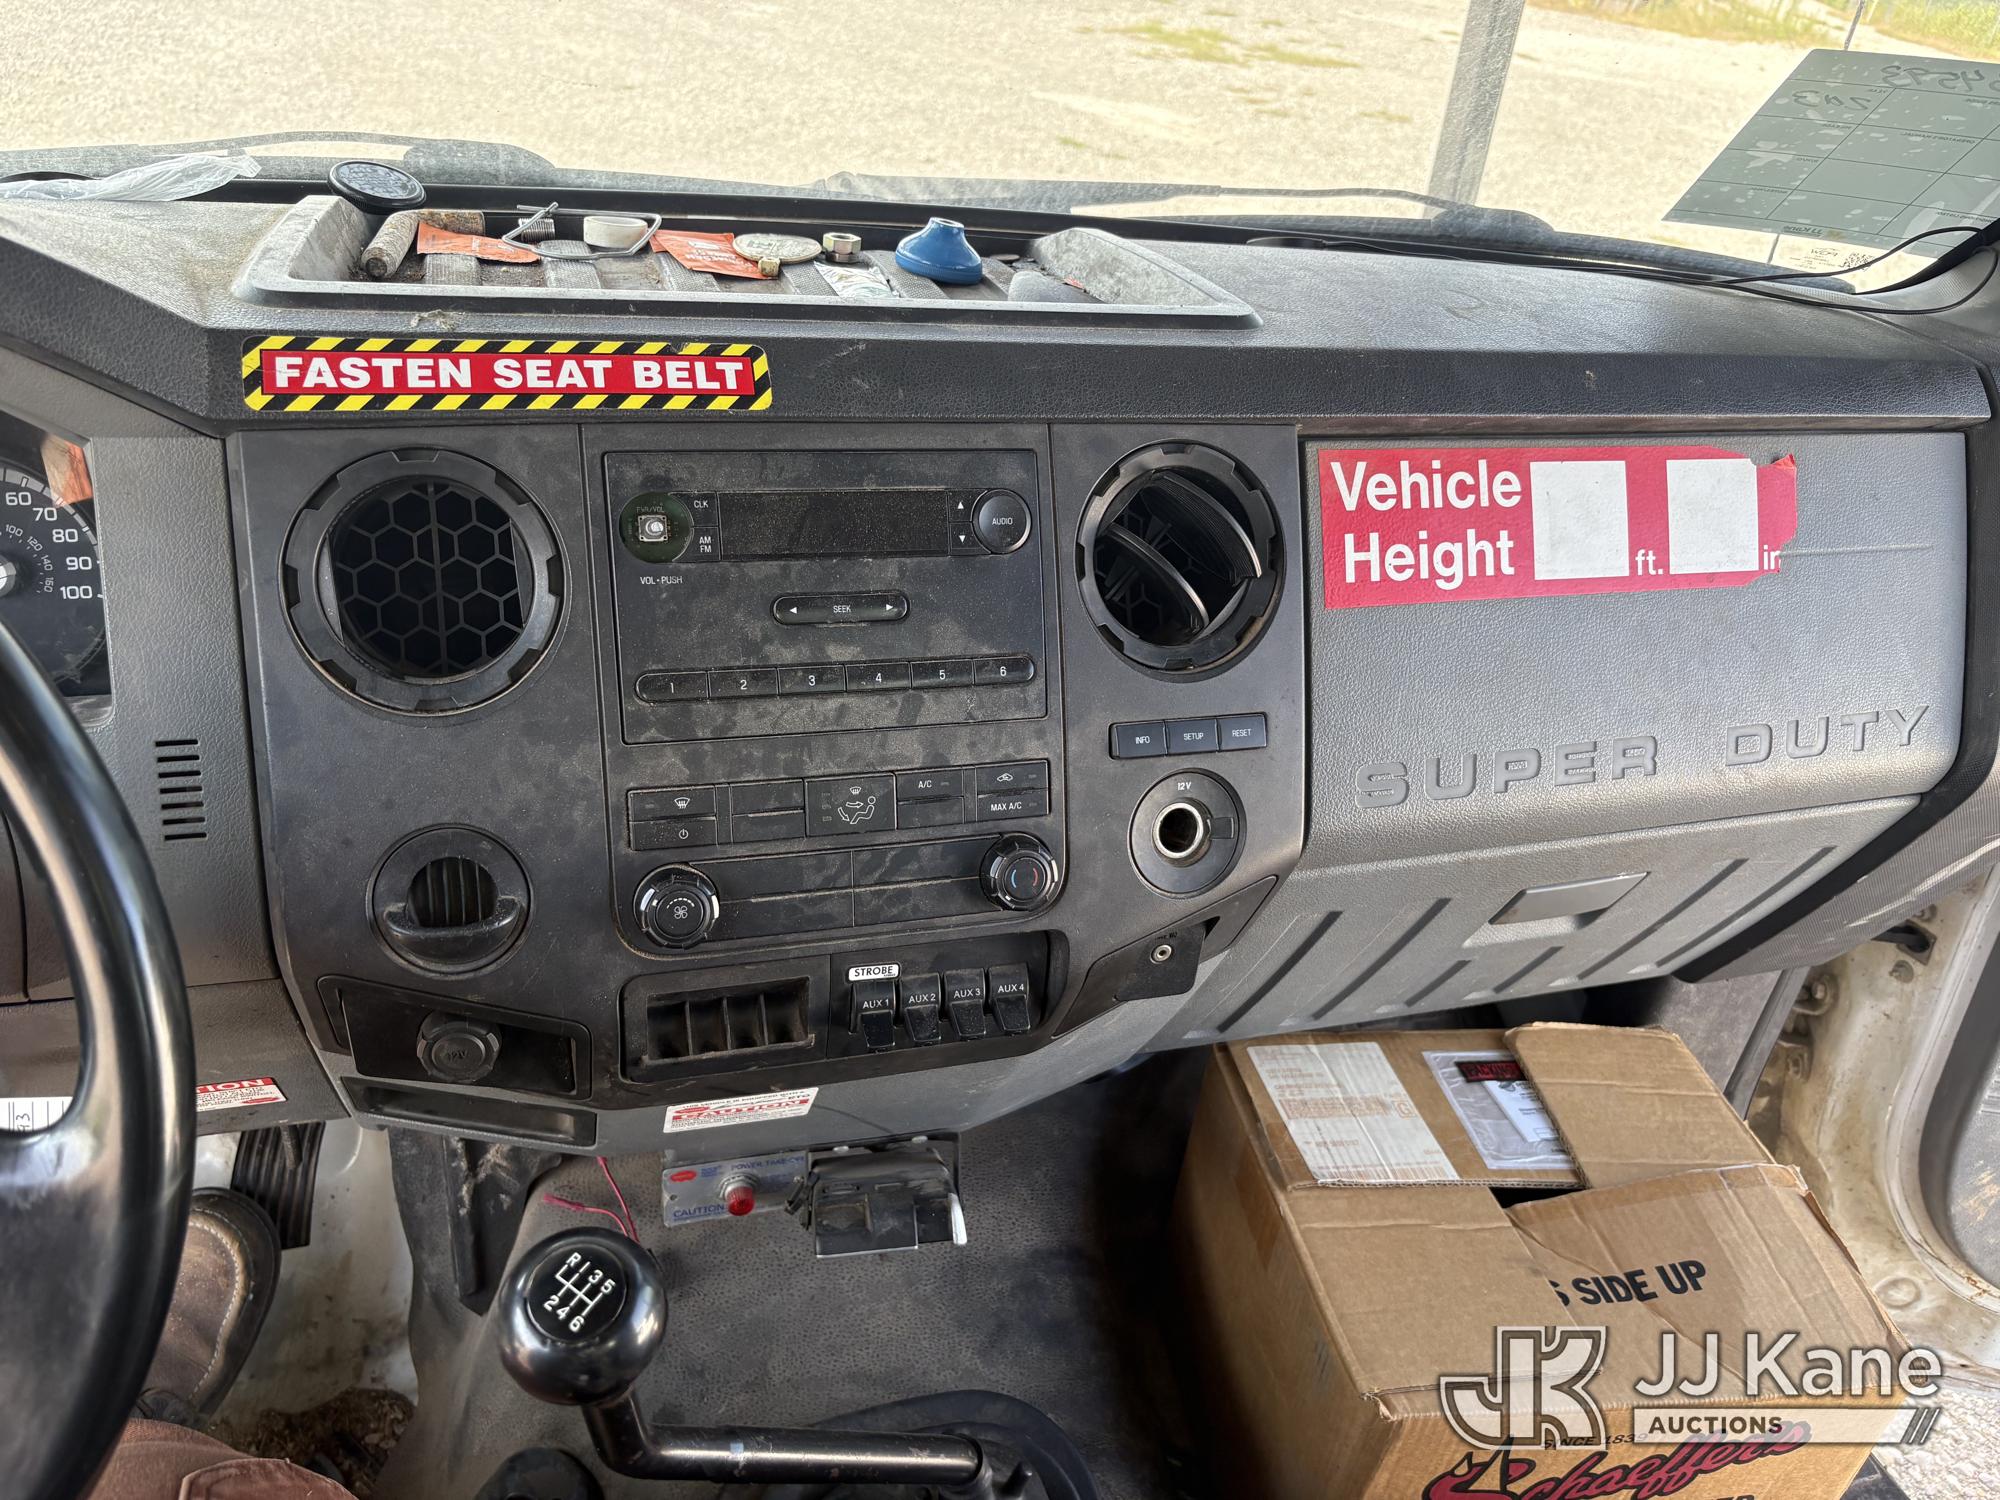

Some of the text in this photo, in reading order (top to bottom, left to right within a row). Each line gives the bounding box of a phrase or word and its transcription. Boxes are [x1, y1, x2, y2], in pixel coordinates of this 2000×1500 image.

[275, 356, 744, 390] FASTEN SEAT BELT
[1331, 459, 1522, 511] Vehicle
[5, 492, 32, 506] 60
[693, 500, 709, 509] CLK
[32, 507, 58, 521] 70
[992, 517, 1013, 526] AUDIO
[5, 524, 24, 537] 100
[52, 529, 79, 543] 80
[26, 536, 43, 552] 120
[699, 536, 712, 545] AM
[699, 545, 712, 553] FM
[41, 554, 53, 571] 140
[66, 556, 92, 571] 90
[1344, 528, 1514, 590] Height
[1635, 549, 1663, 576] ft.
[661, 575, 683, 584] PUSH
[60, 585, 93, 599] 100
[832, 604, 852, 613] SEEK
[875, 672, 883, 684] 4
[938, 669, 946, 681] 5
[999, 665, 1007, 678] 6
[739, 679, 748, 691] 2
[808, 674, 816, 687] 3
[669, 681, 676, 694] 1
[1183, 732, 1204, 741] SETUP
[1232, 728, 1252, 737] RESET
[1135, 736, 1151, 745] INFO
[1356, 704, 1929, 808] SUPER DUTY
[918, 779, 932, 789] A/C
[990, 802, 1022, 812] MAX A/C
[854, 965, 893, 977] STROBE
[954, 987, 981, 998] AUX 3
[997, 983, 1025, 993] AUX 4
[862, 999, 882, 1009] AUX
[909, 993, 936, 1004] AUX 2
[673, 1204, 725, 1218] CAUTION
[566, 1252, 582, 1267] R
[588, 1269, 603, 1283] 3
[600, 1279, 616, 1294] 5
[1572, 1269, 1658, 1305] SIDE
[1655, 1260, 1706, 1294] UP
[543, 1295, 585, 1332] 2 4 6
[1543, 1436, 1596, 1449] SINCE
